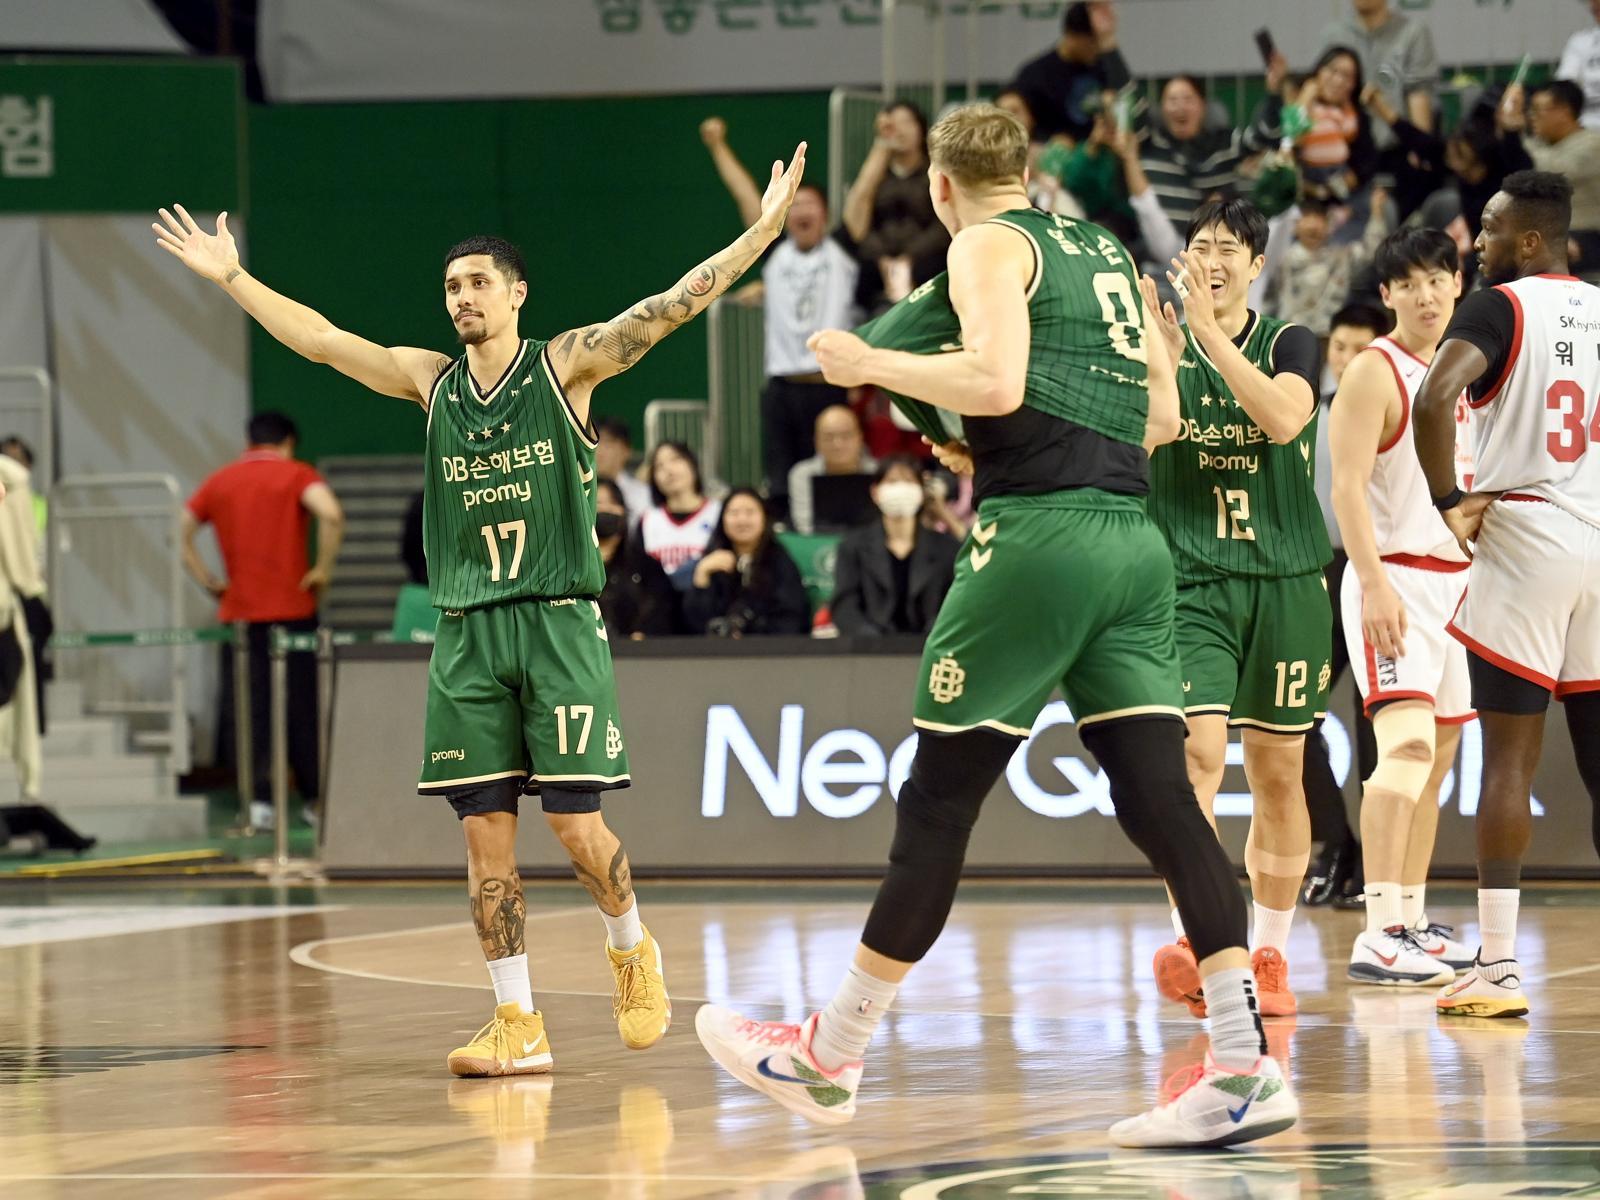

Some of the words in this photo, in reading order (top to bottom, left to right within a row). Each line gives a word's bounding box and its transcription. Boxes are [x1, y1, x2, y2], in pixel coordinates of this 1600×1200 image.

[1559, 315, 1576, 329] SK
[1179, 418, 1275, 446] DB손해보
[1546, 380, 1600, 463] 3
[442, 439, 555, 482] DB손해보험
[463, 480, 532, 511] promy
[1213, 486, 1256, 541] 12
[480, 519, 527, 582] 17
[1274, 660, 1307, 708] 12
[553, 704, 595, 755] 17
[431, 748, 465, 764] promy
[701, 704, 919, 819] Ne
